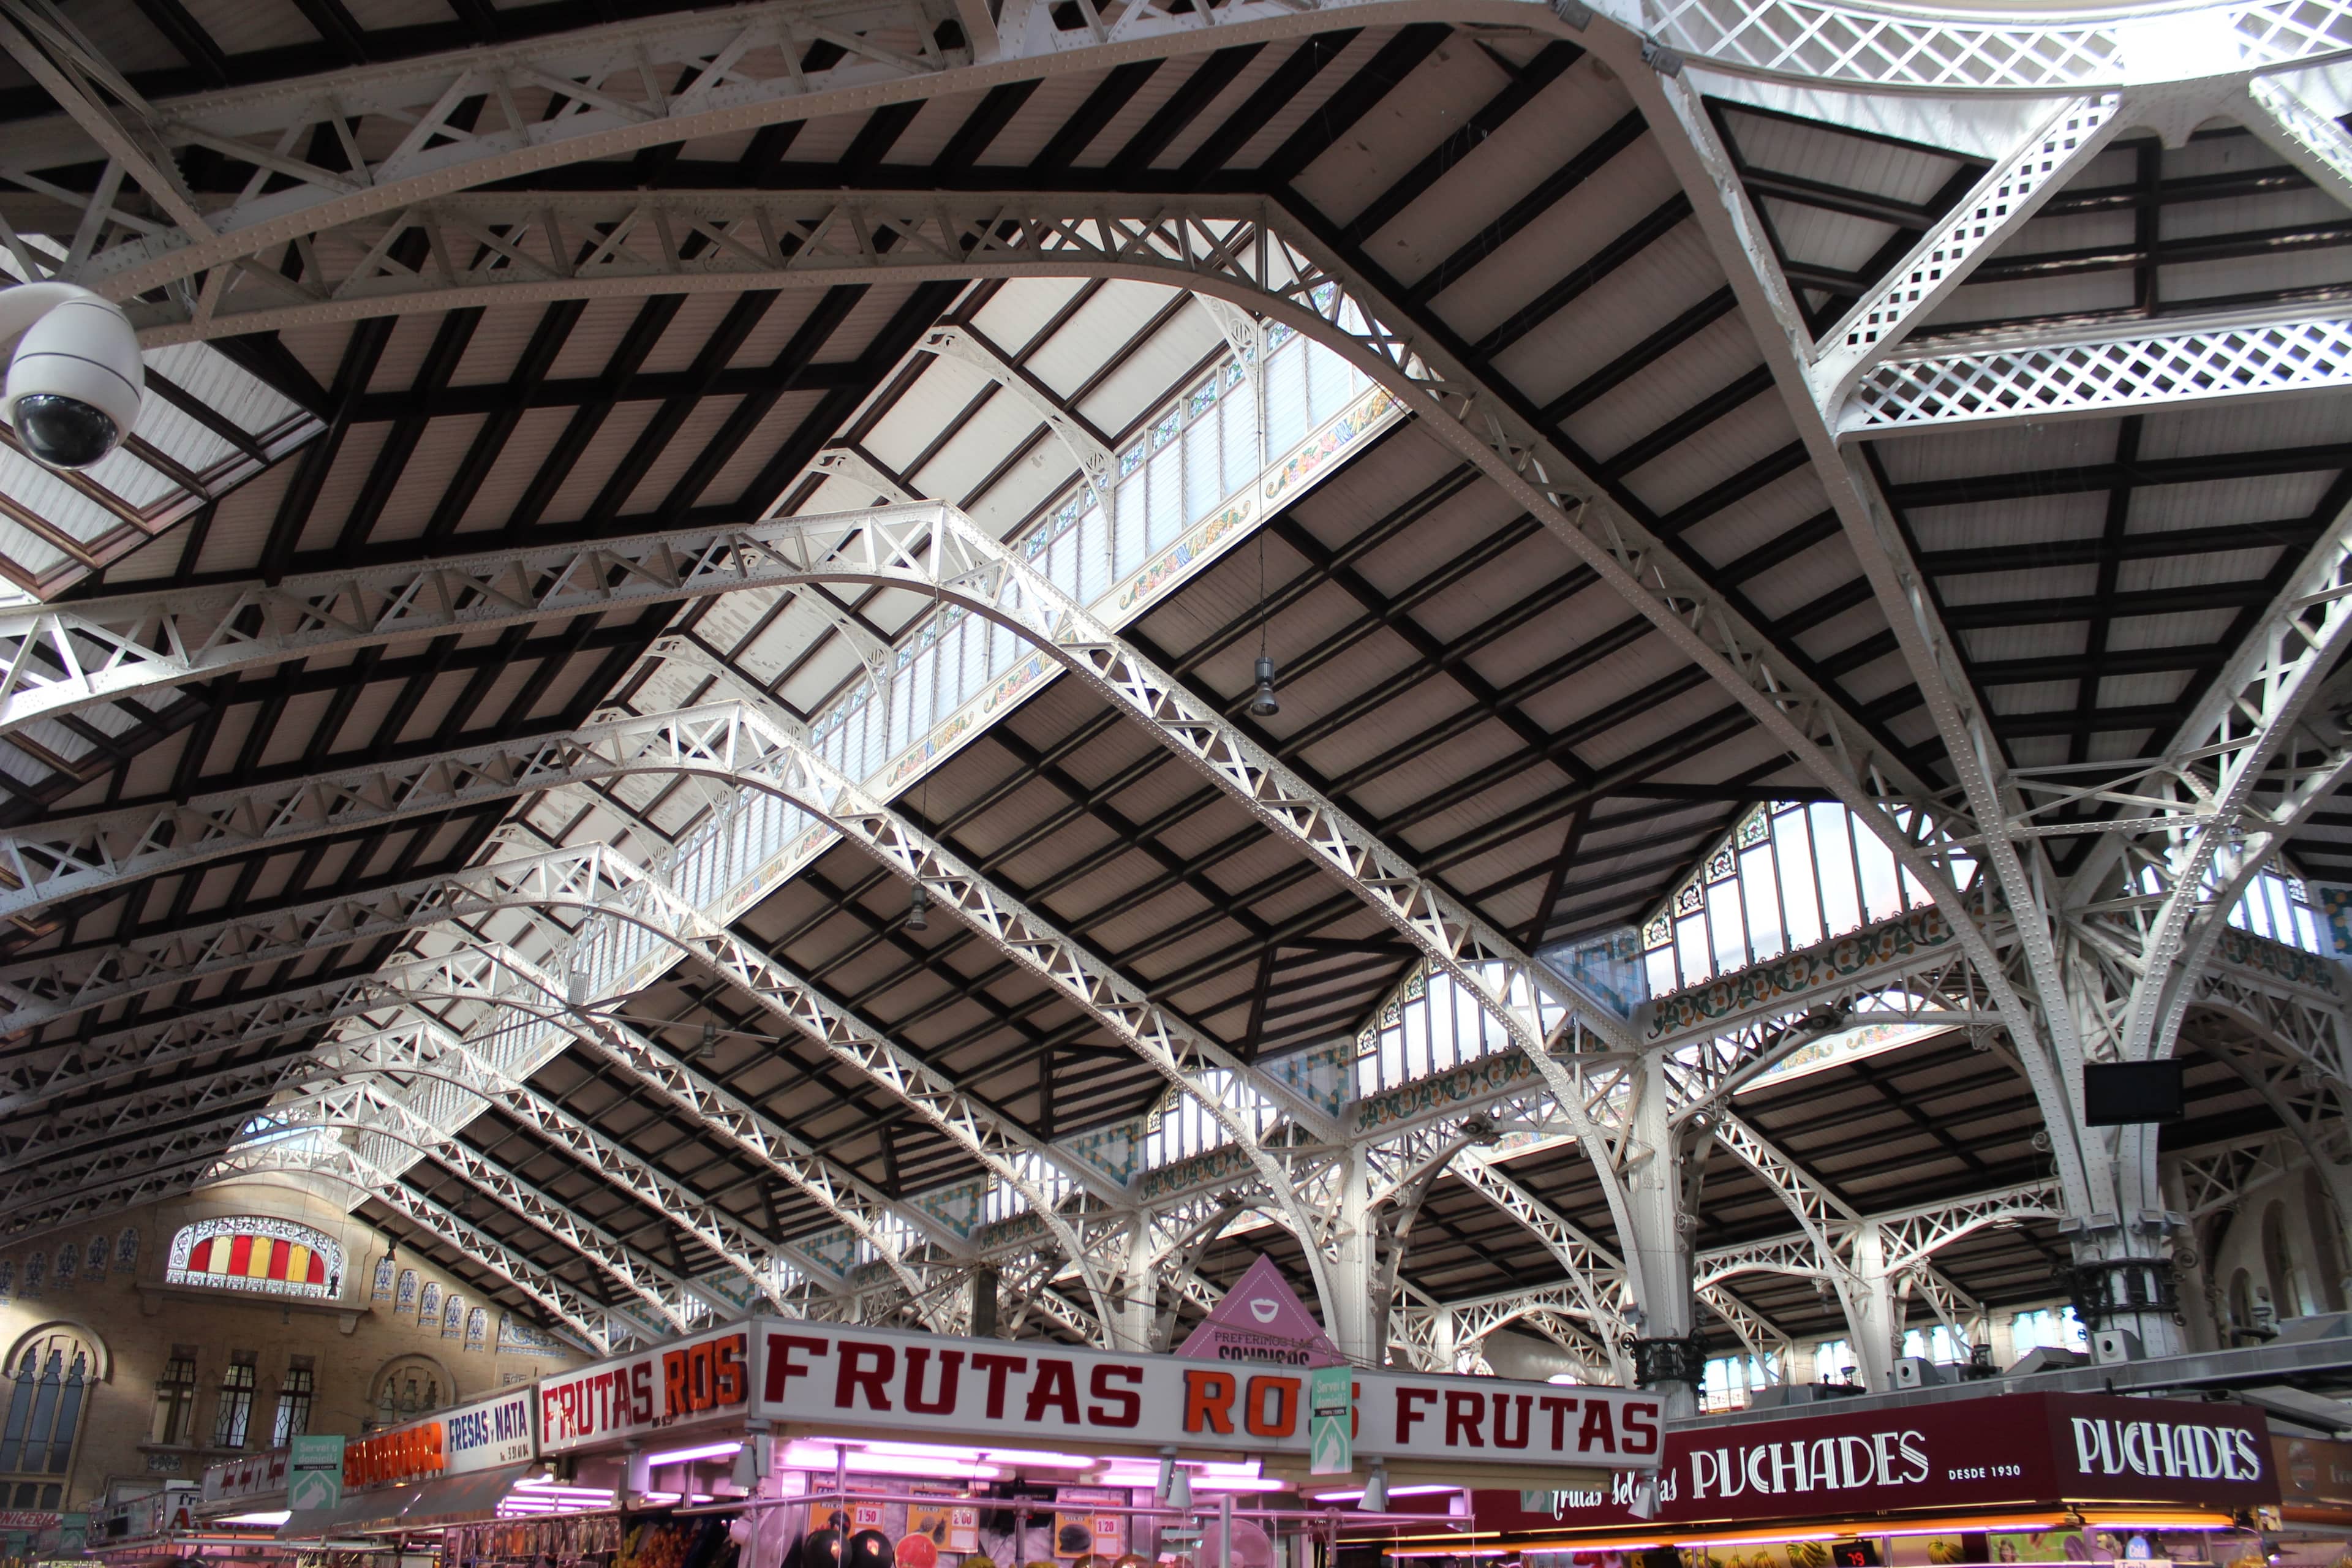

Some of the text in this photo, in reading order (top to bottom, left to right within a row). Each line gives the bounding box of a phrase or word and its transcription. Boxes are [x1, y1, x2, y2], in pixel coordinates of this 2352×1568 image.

[1215, 1332, 1287, 1346] PREFERIMOS
[542, 1333, 748, 1443] FRUTAS ROS
[764, 1333, 1144, 1428] FRUTAS
[1395, 1387, 1659, 1455] FRUTAS
[448, 1410, 489, 1452] FRESAS
[495, 1400, 527, 1442] NATA
[2070, 1417, 2261, 1482] PUCHADES
[1689, 1430, 1929, 1500] PUCHADES
[1948, 1466, 1986, 1480] DESDE
[1991, 1464, 2021, 1477] 1930
[1847, 1551, 1865, 1567] 79
